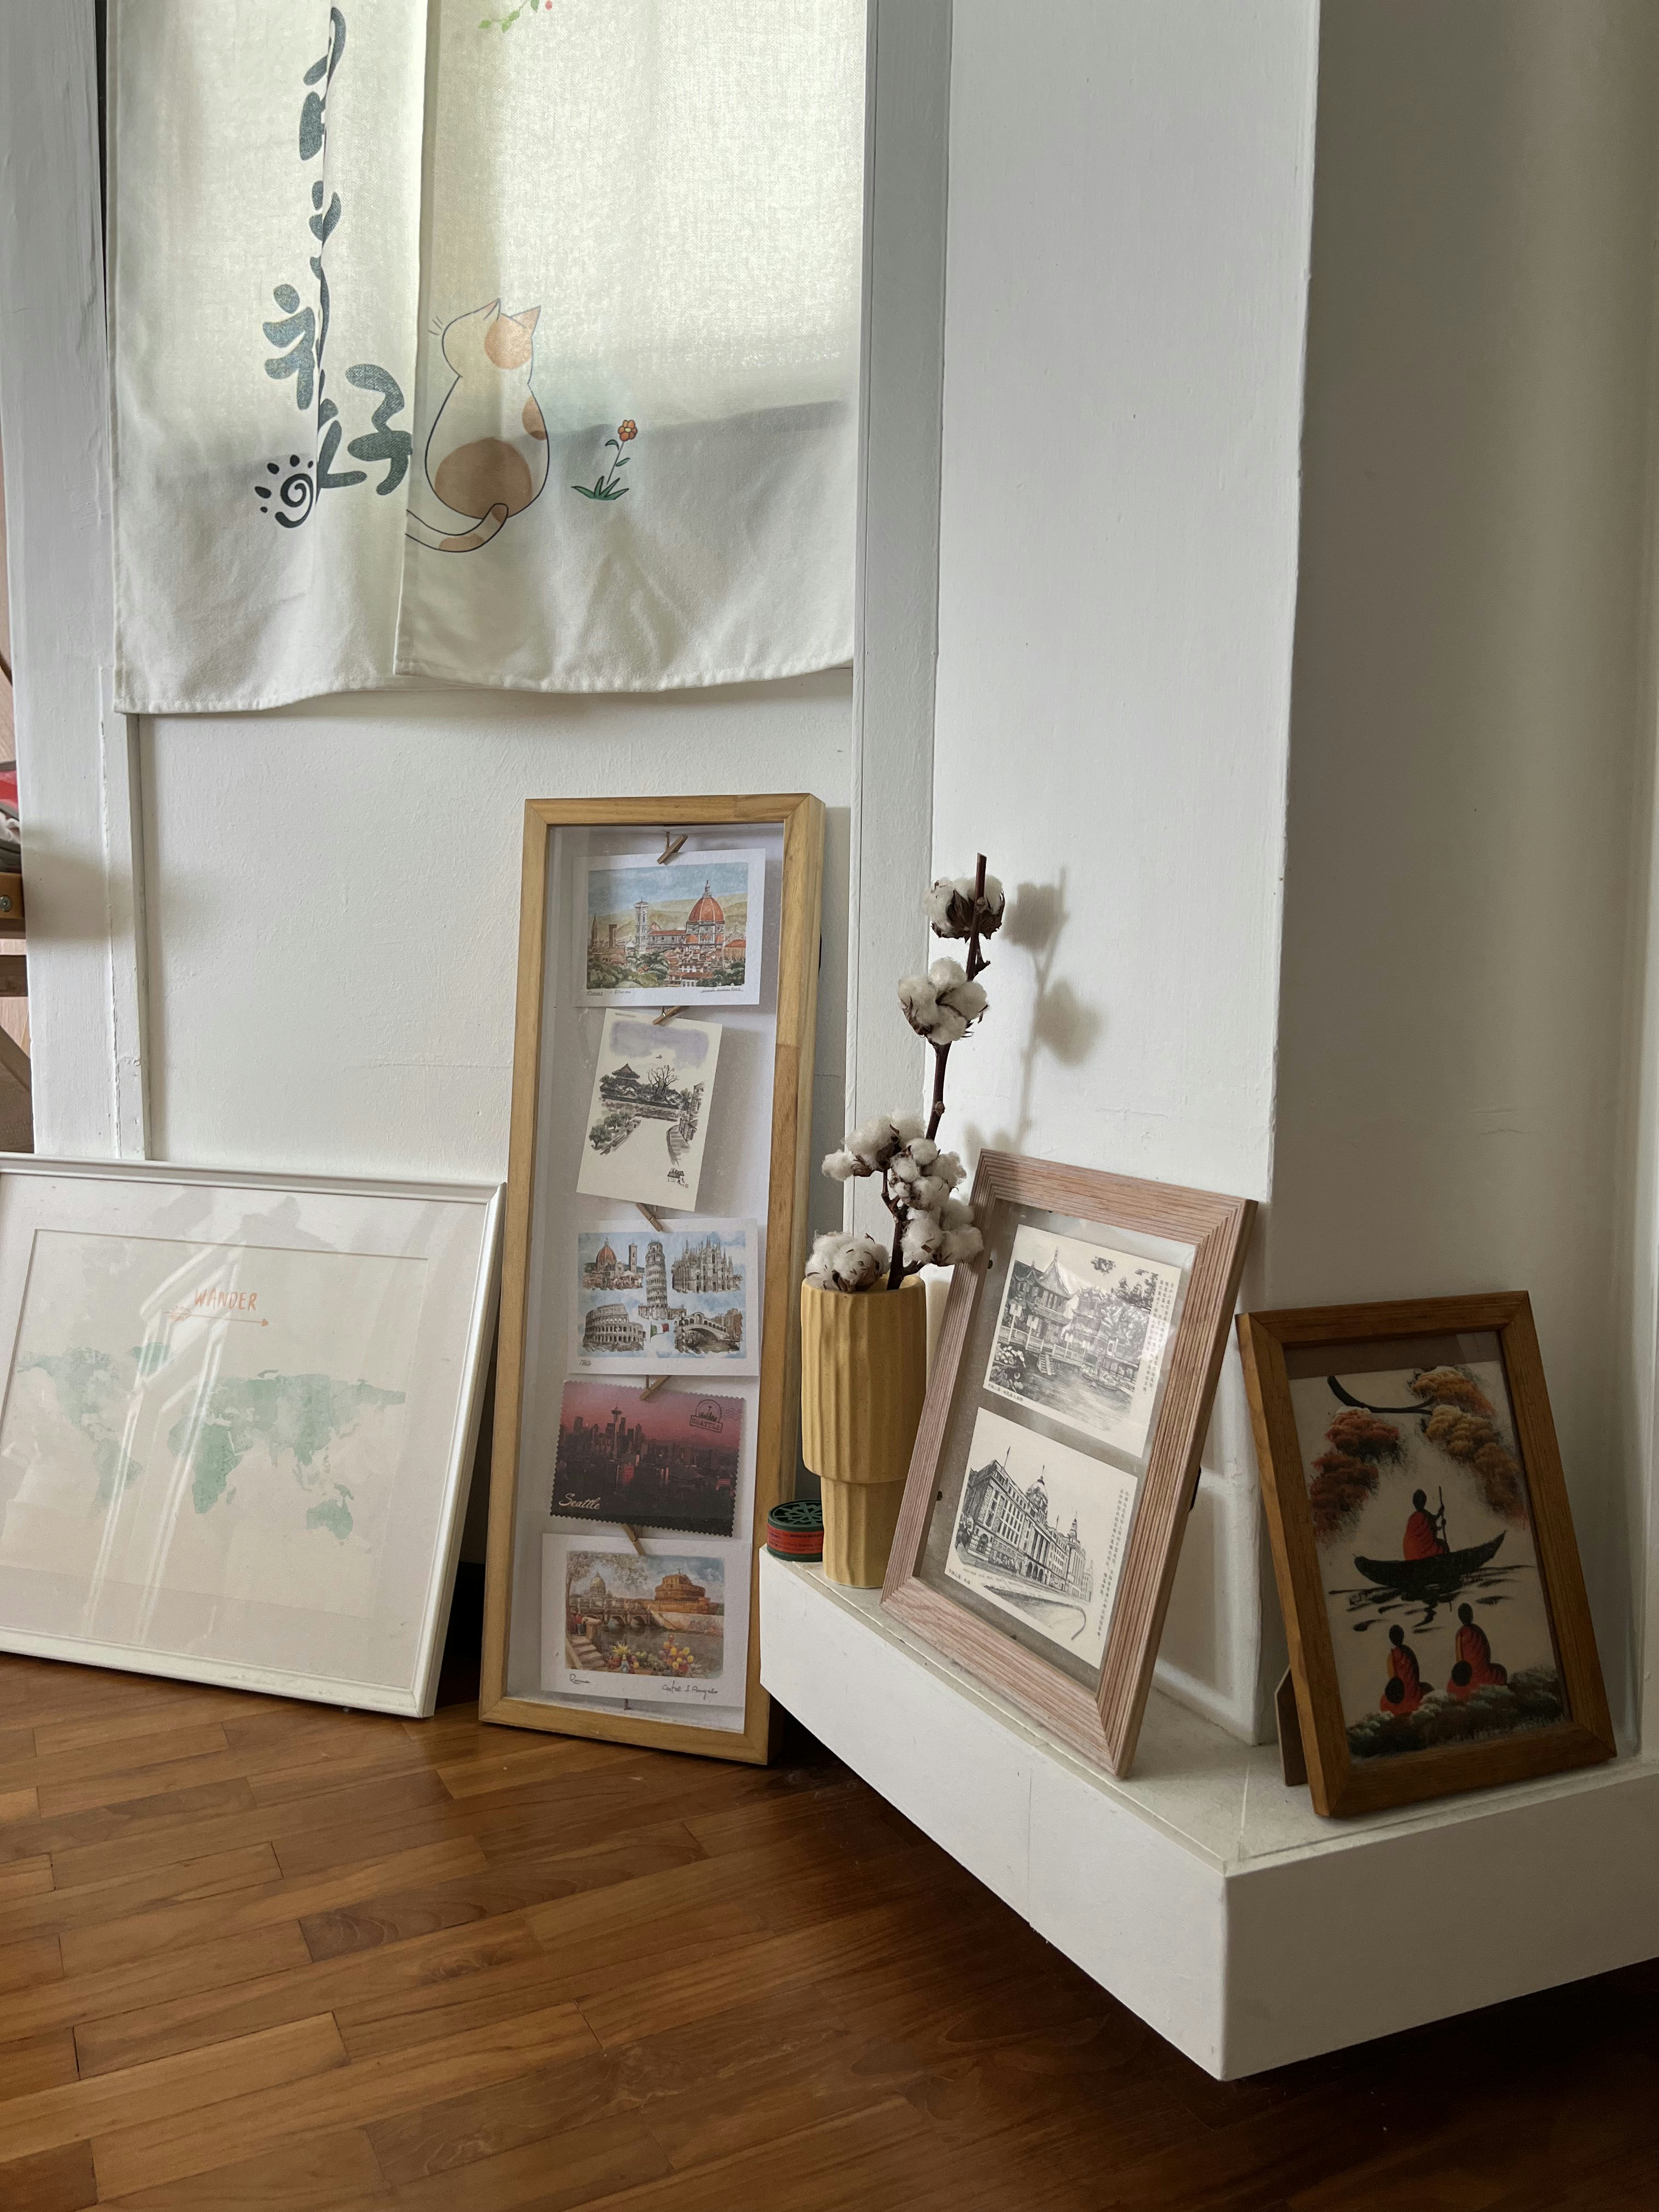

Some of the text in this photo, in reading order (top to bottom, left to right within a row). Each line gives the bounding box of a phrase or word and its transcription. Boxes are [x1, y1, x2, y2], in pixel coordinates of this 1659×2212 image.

[194, 1288, 258, 1311] WANDER
[691, 1418, 720, 1430] SEATTLE
[558, 1493, 601, 1510] Seattle
